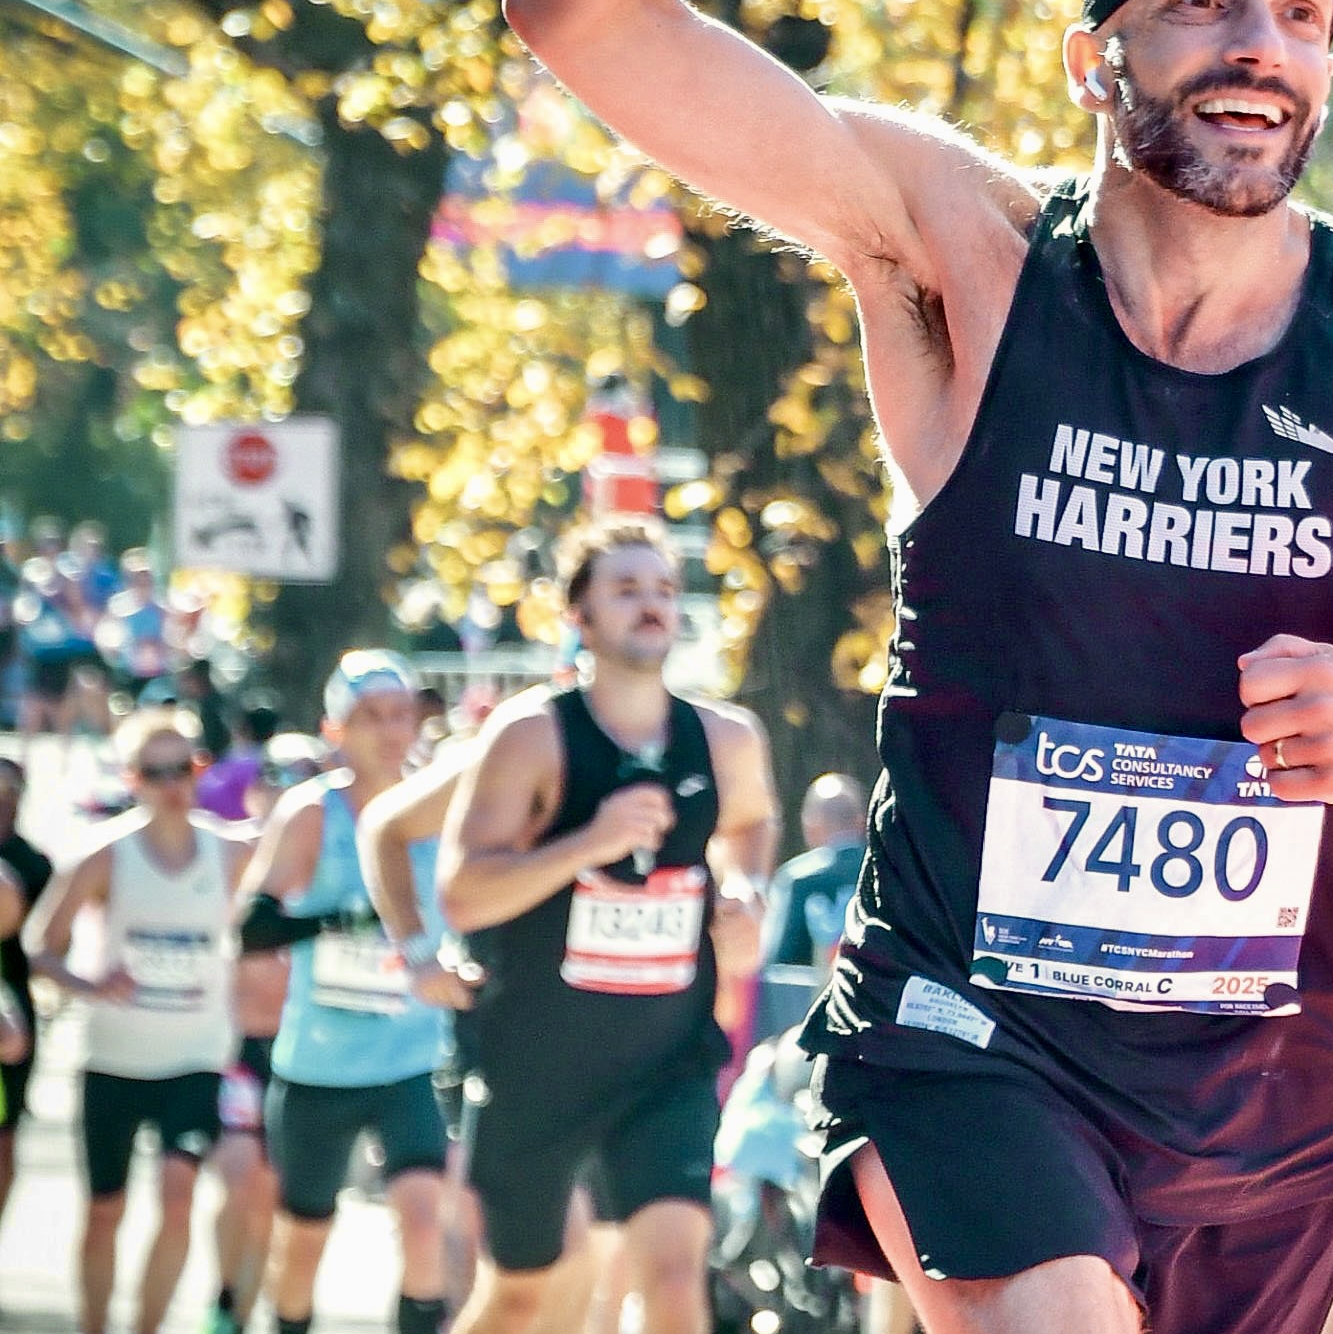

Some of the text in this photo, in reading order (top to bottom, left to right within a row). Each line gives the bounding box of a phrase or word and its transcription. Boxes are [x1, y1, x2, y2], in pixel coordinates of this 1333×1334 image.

[1049, 423, 1313, 509] NEW YORK
[1014, 473, 1333, 579] HARRIERS
[1035, 731, 1105, 783] tcs
[1113, 742, 1158, 760] TATA
[1109, 772, 1175, 790] SERVICES
[1111, 758, 1213, 780] CONSULTANCY
[1041, 795, 1269, 902] 7480
[1029, 963, 1040, 979] 1
[1052, 970, 1090, 986] BLUE
[1094, 975, 1152, 993] CORRAL
[1156, 978, 1173, 994] C
[1211, 976, 1269, 995] 2025
